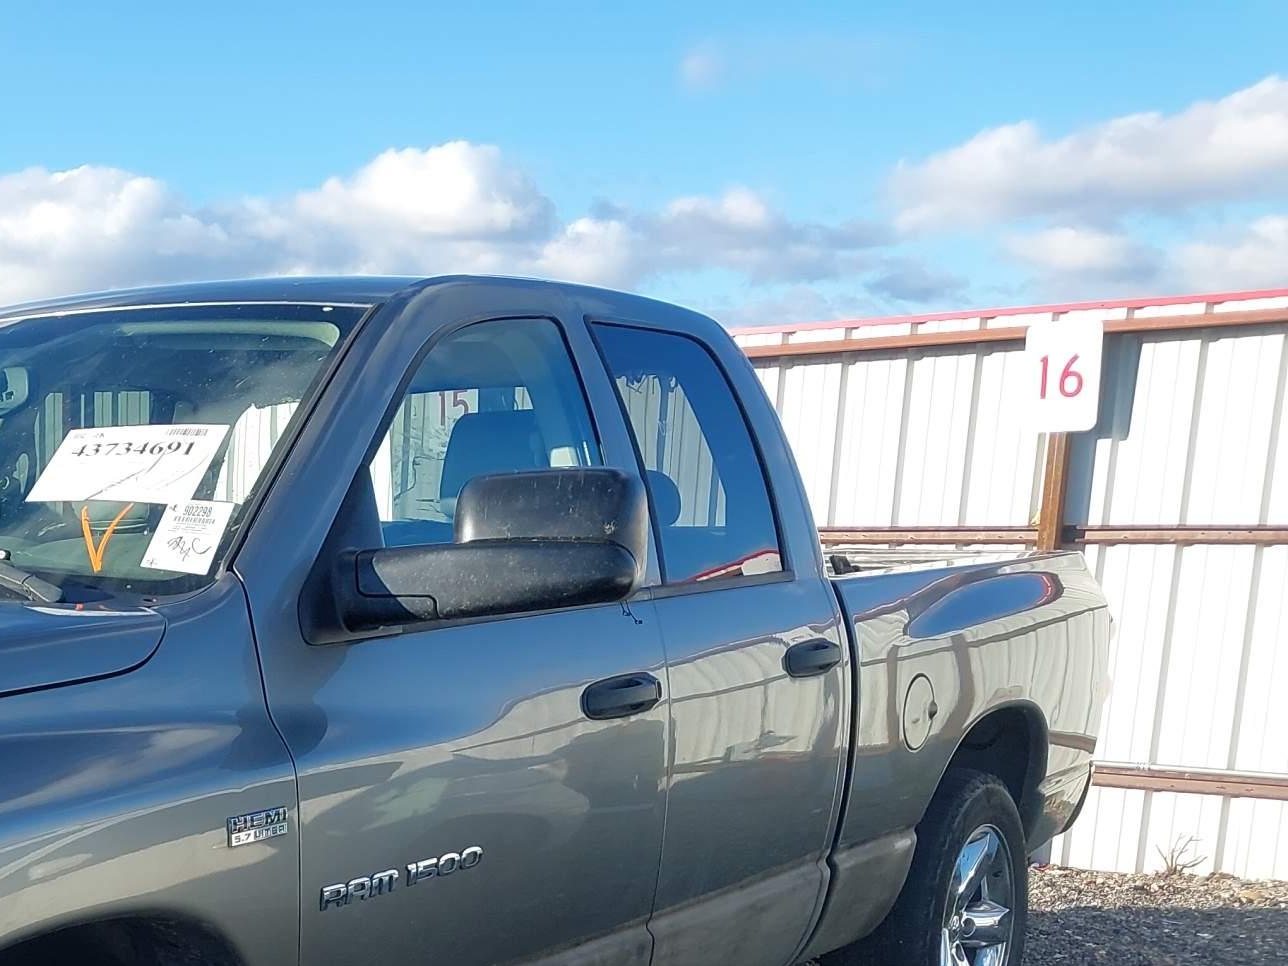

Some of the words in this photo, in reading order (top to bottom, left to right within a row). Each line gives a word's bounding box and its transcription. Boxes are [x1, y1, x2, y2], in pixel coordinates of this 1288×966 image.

[1040, 353, 1083, 399] 16
[72, 441, 195, 457] 43734691
[183, 505, 213, 518] 902298
[231, 807, 289, 834] HEMI
[233, 831, 253, 845] 5.7
[319, 868, 399, 911] RAM
[406, 845, 484, 887] 1500
